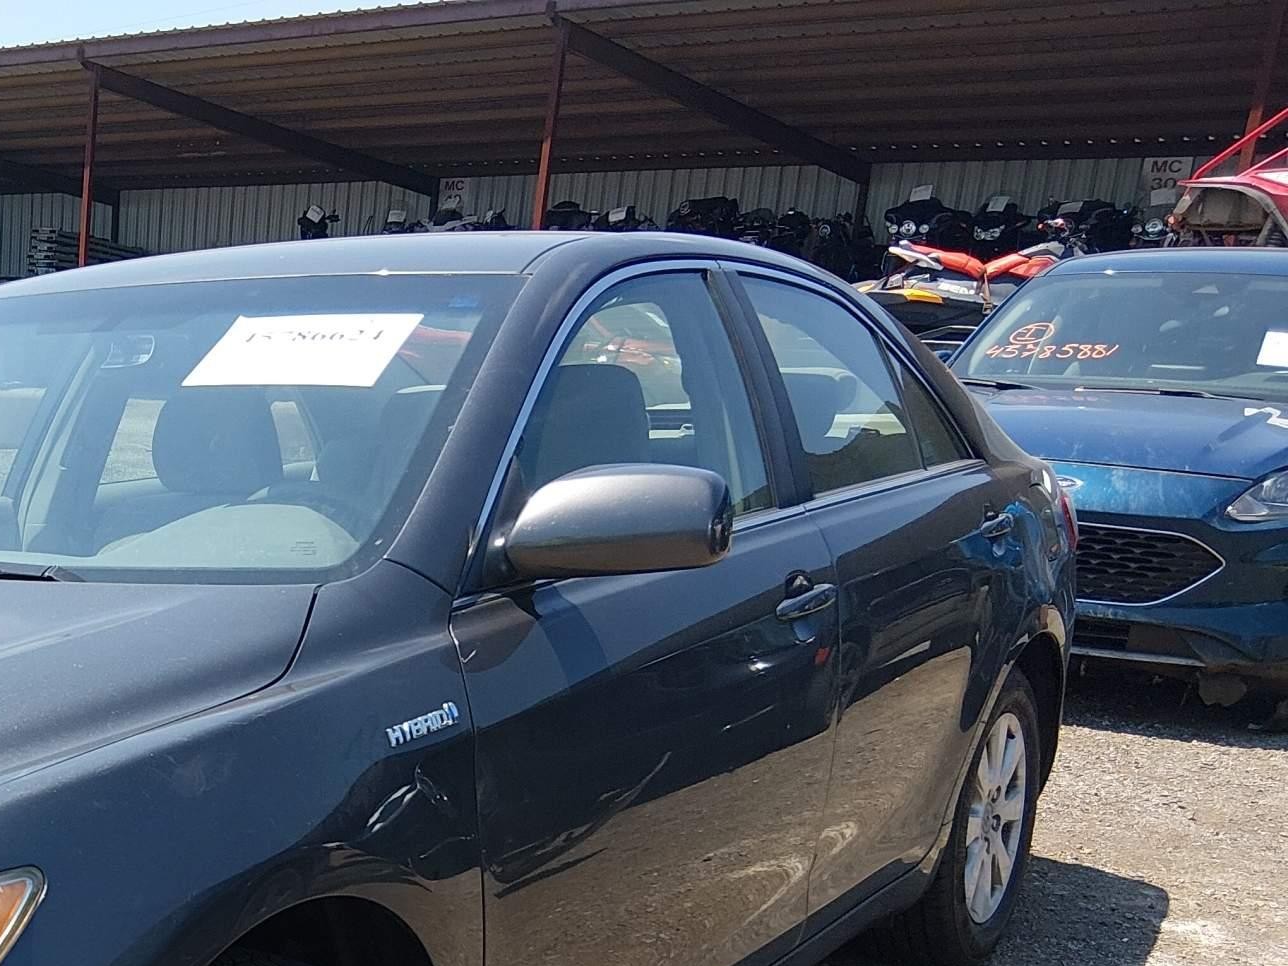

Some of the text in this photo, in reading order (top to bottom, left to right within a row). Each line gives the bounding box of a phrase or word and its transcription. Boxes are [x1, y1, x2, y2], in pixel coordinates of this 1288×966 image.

[1151, 160, 1182, 173] MC
[444, 180, 465, 191] MC
[985, 342, 1120, 359] 45785881
[385, 709, 448, 747] HYBRID
